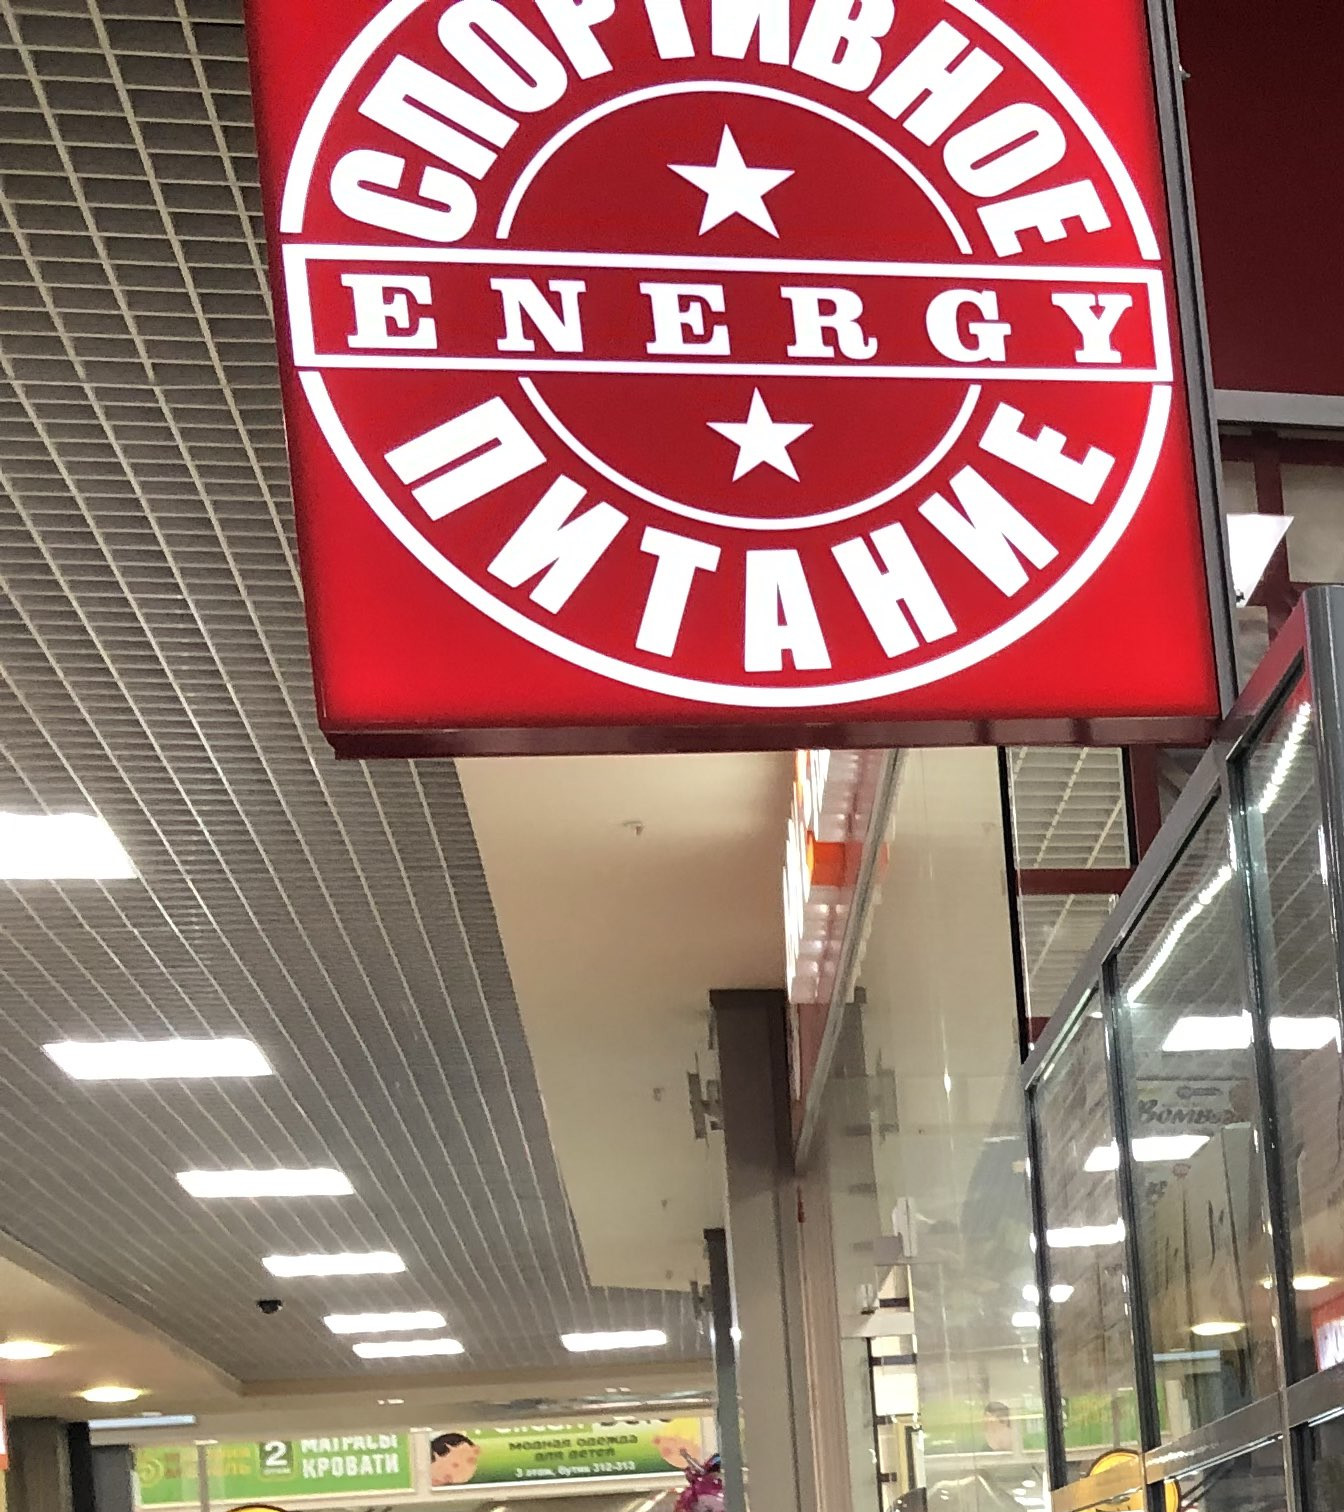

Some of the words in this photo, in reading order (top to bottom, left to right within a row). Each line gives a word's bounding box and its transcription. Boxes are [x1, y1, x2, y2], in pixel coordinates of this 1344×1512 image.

[340, 273, 1133, 365] ENERGY
[385, 395, 1116, 672] ПИТАНИЕ
[265, 1441, 287, 1466] 2
[302, 1453, 399, 1478] КРОВАТИ
